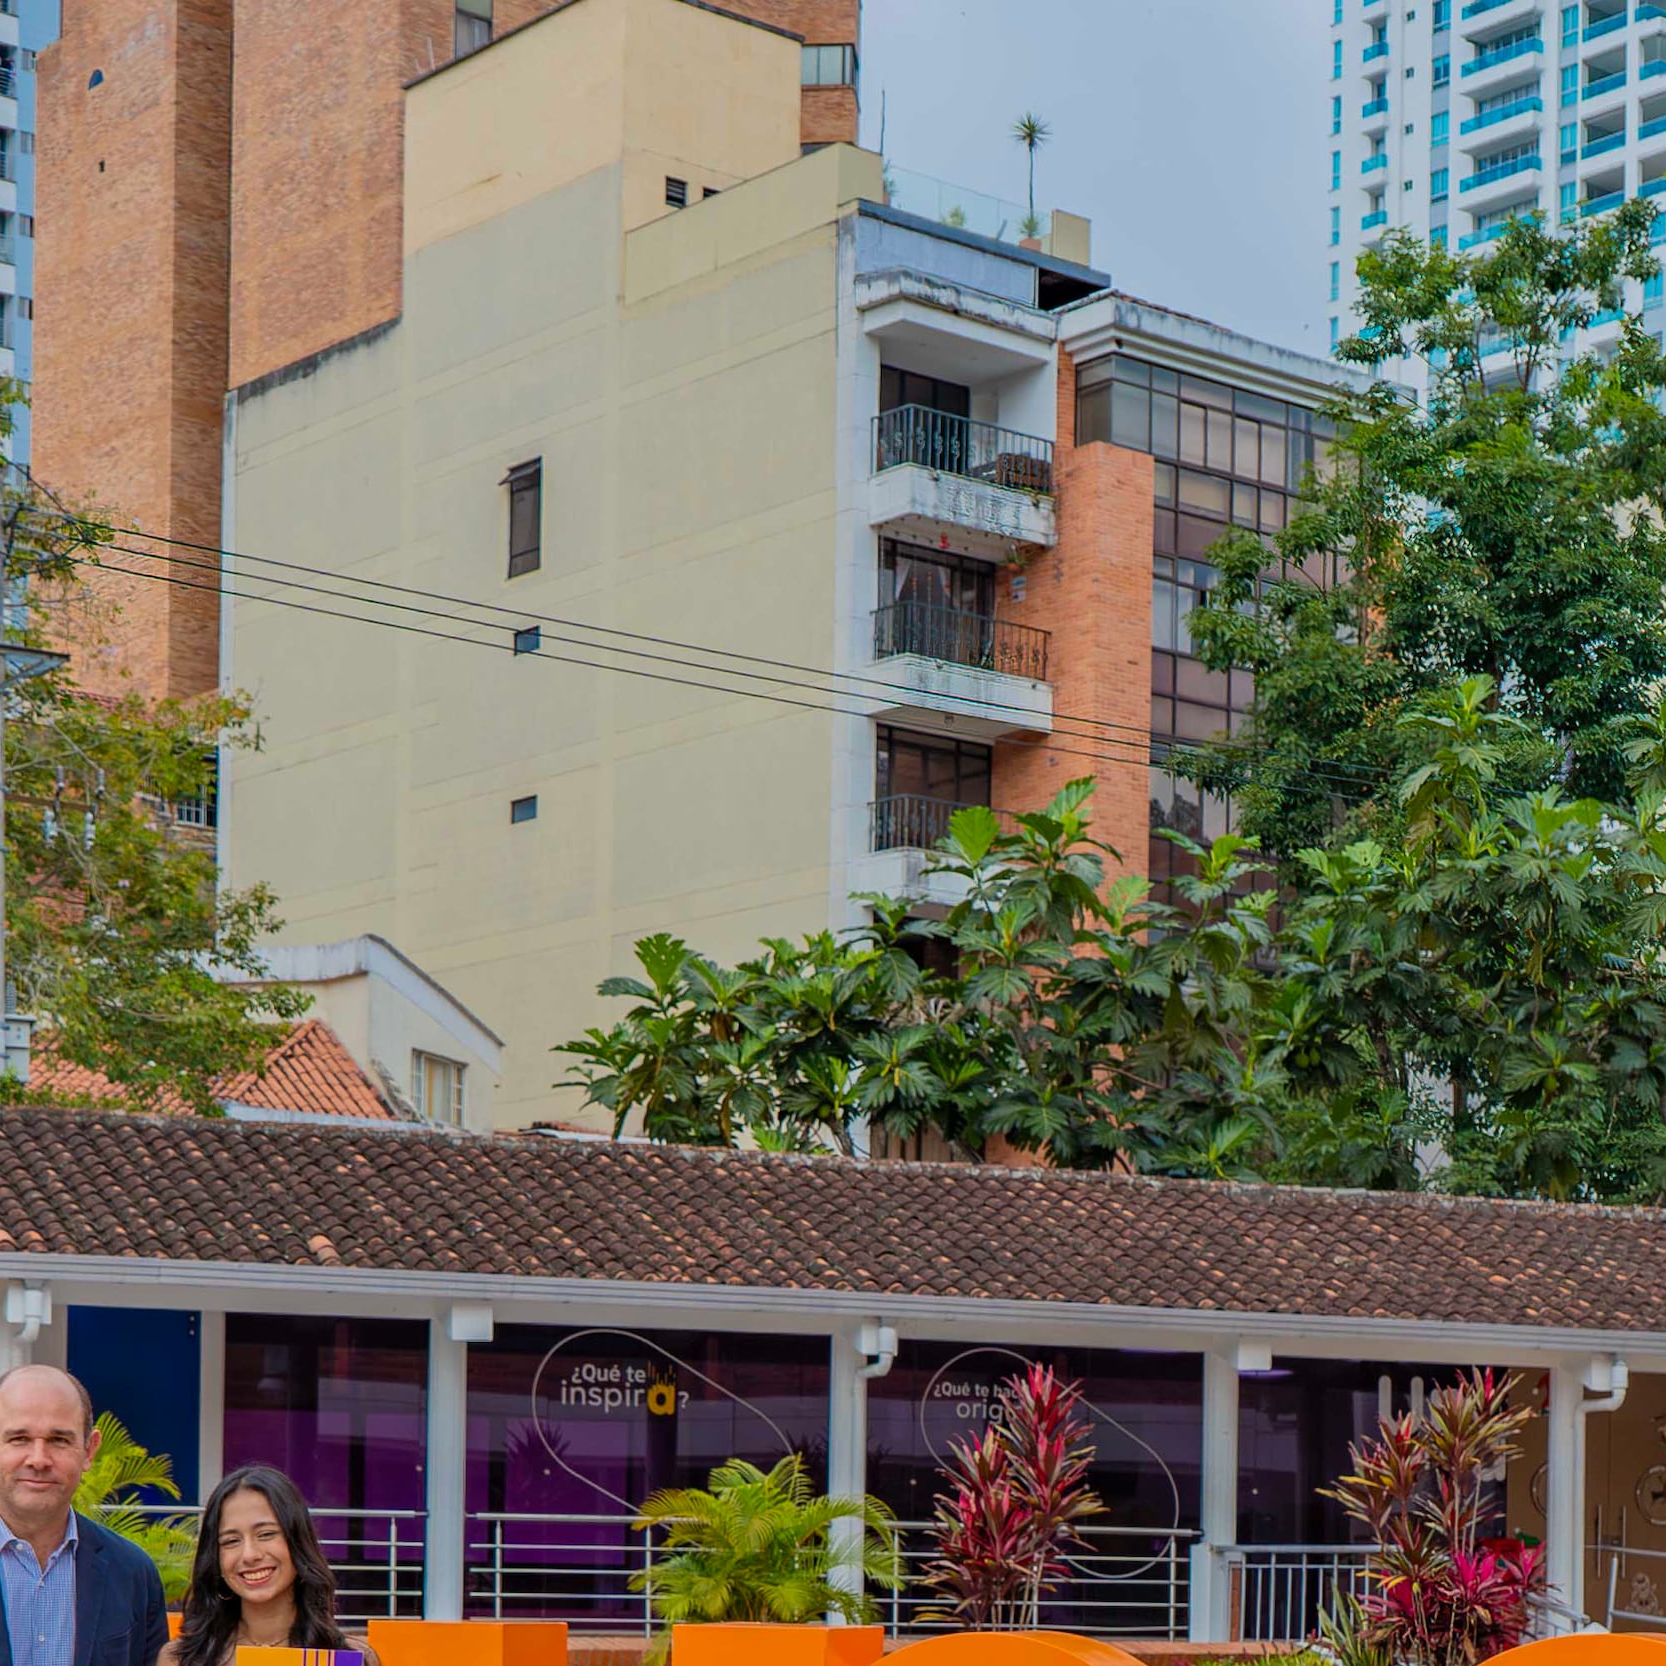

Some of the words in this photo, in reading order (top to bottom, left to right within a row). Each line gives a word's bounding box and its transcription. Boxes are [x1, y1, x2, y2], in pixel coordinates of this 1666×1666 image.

[571, 1363, 621, 1383] ¿Qué
[626, 1366, 646, 1382] te
[934, 1381, 970, 1397] ¿Qué
[975, 1383, 989, 1397] te
